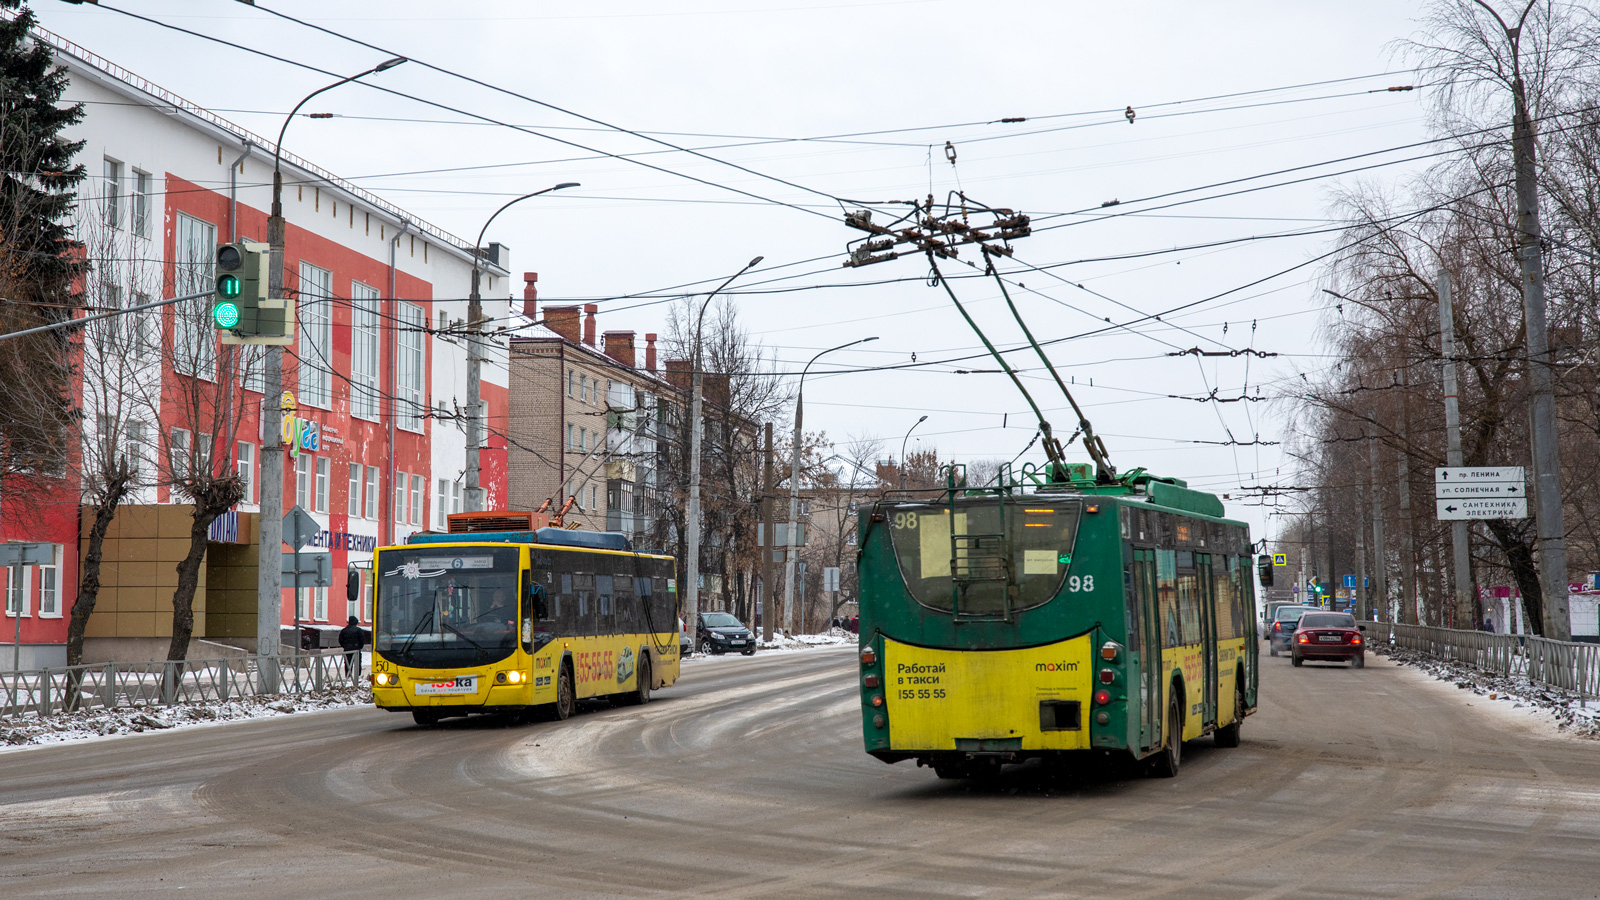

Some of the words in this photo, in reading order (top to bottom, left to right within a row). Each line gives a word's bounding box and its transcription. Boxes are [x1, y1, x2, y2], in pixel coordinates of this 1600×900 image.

[227, 280, 239, 294] 11
[894, 511, 918, 530] 98
[335, 531, 342, 550] И
[342, 532, 377, 553] ТЕХНИКИ
[455, 559, 460, 568] 6
[1069, 575, 1095, 592] 98
[375, 660, 389, 672] 50
[897, 662, 946, 674] Работай
[1035, 660, 1078, 672] maxim
[897, 676, 904, 685] в
[906, 676, 940, 685] такси
